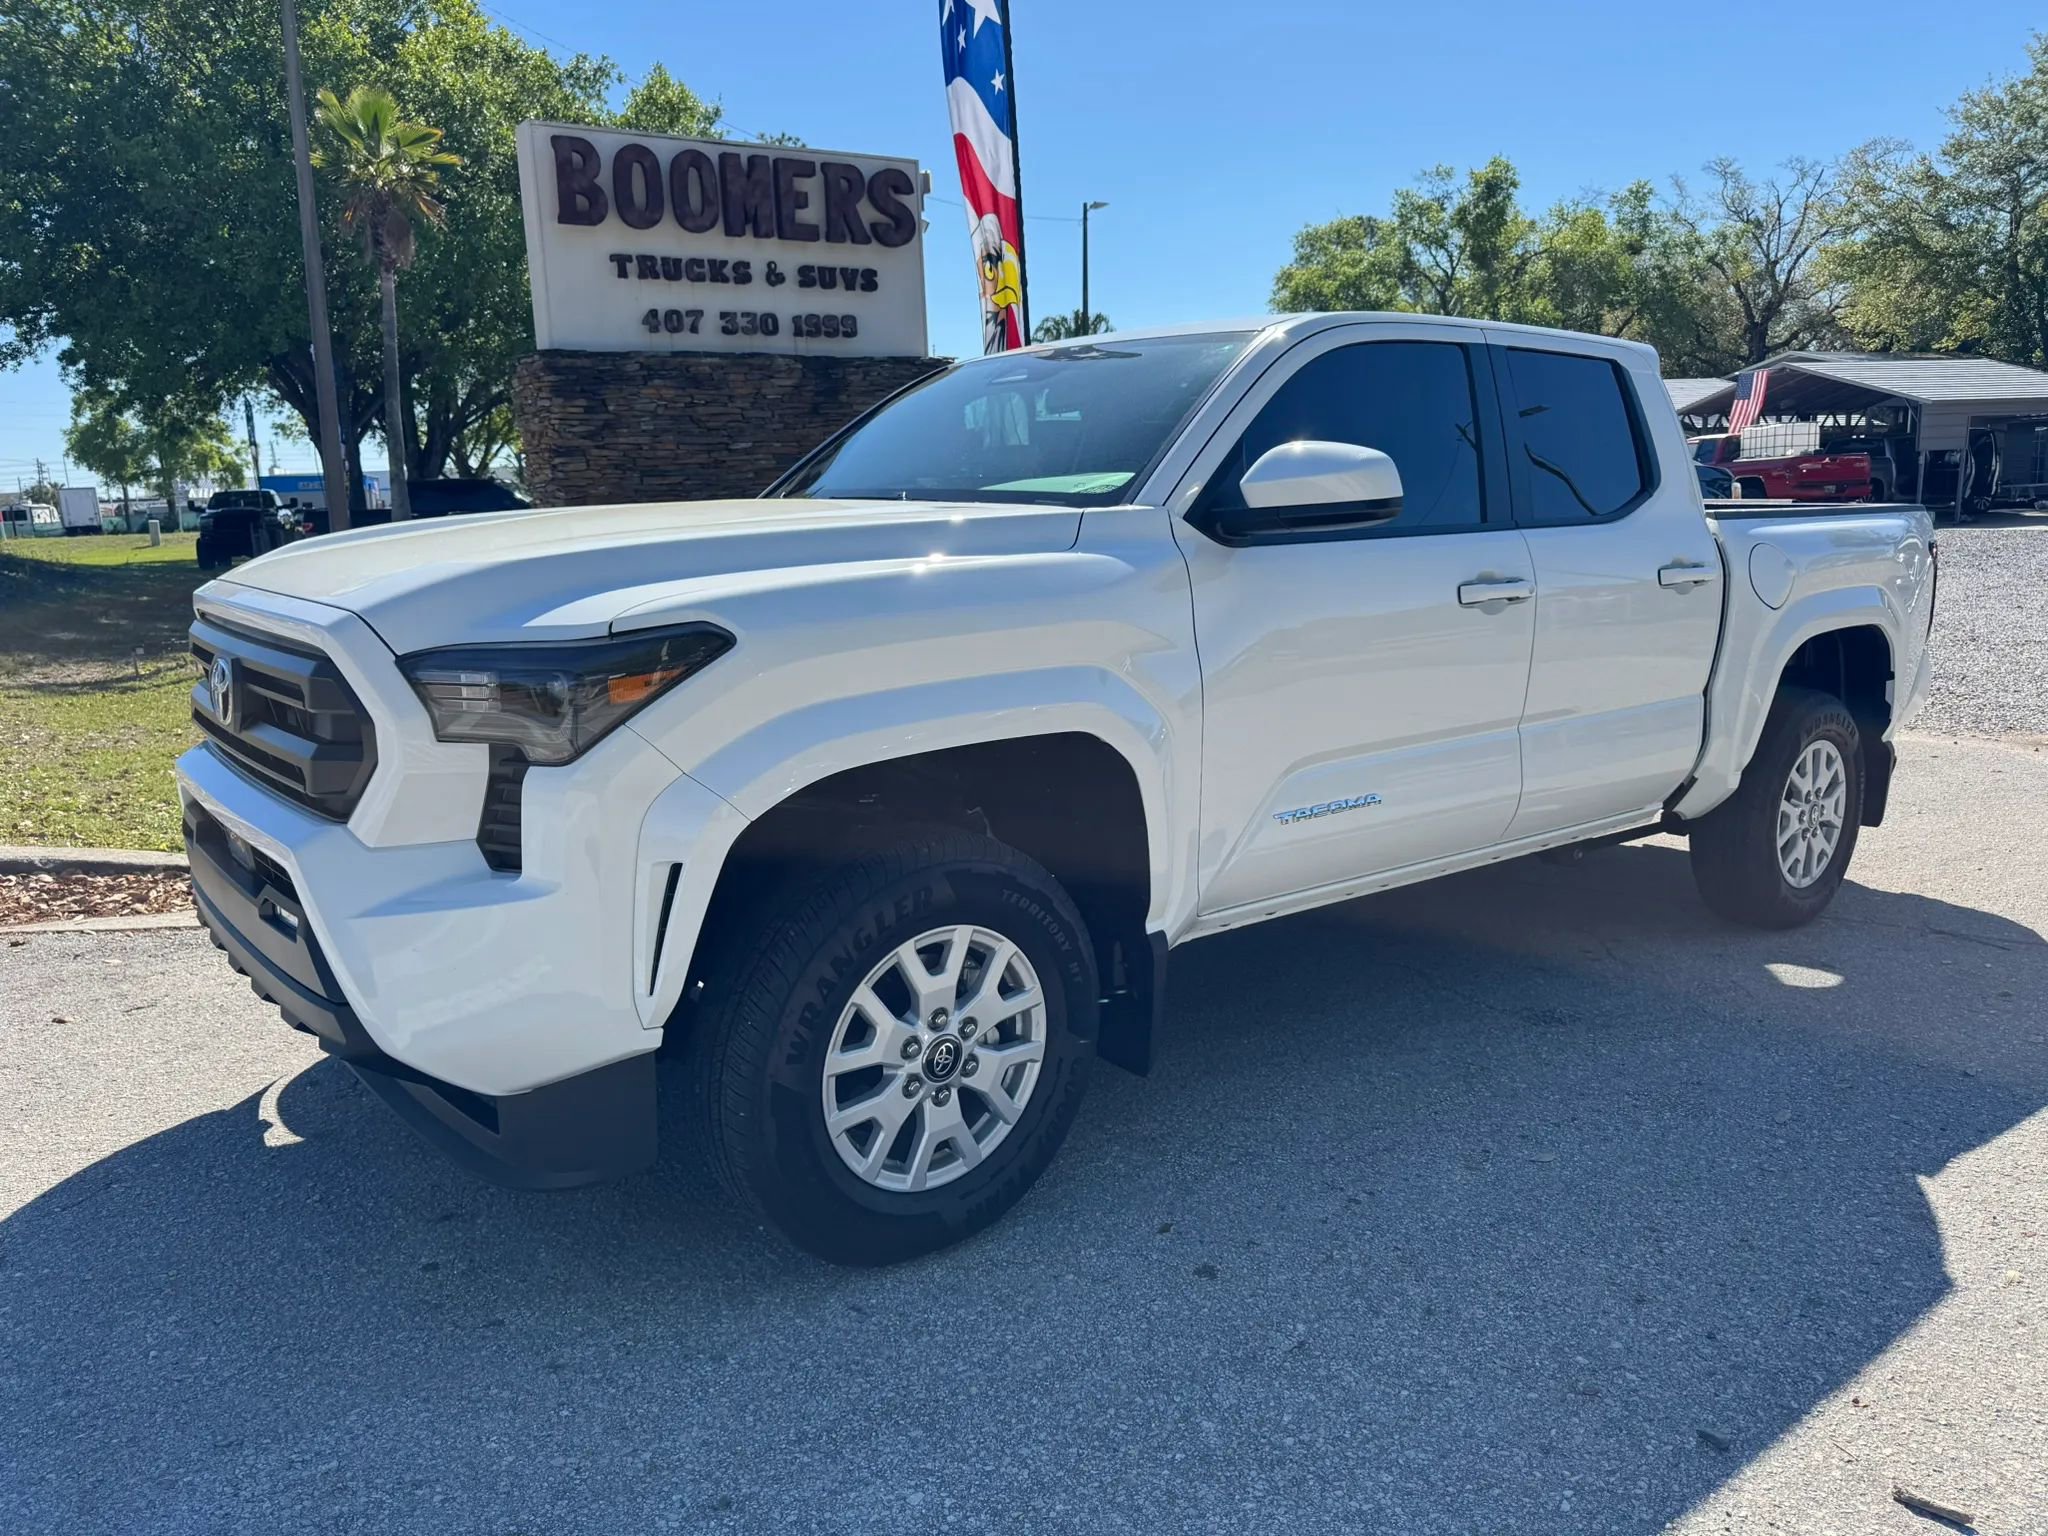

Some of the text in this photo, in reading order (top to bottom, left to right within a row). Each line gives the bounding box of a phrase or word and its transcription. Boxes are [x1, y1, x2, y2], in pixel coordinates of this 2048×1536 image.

[550, 134, 917, 248] BOOMERS
[609, 253, 879, 292] TRUCKS & SUVS
[641, 308, 859, 340] 407 330 1999
[1272, 792, 1383, 826] TACOMA
[1000, 888, 1073, 952] TERRITORY
[785, 885, 934, 1065] WRANGLER
